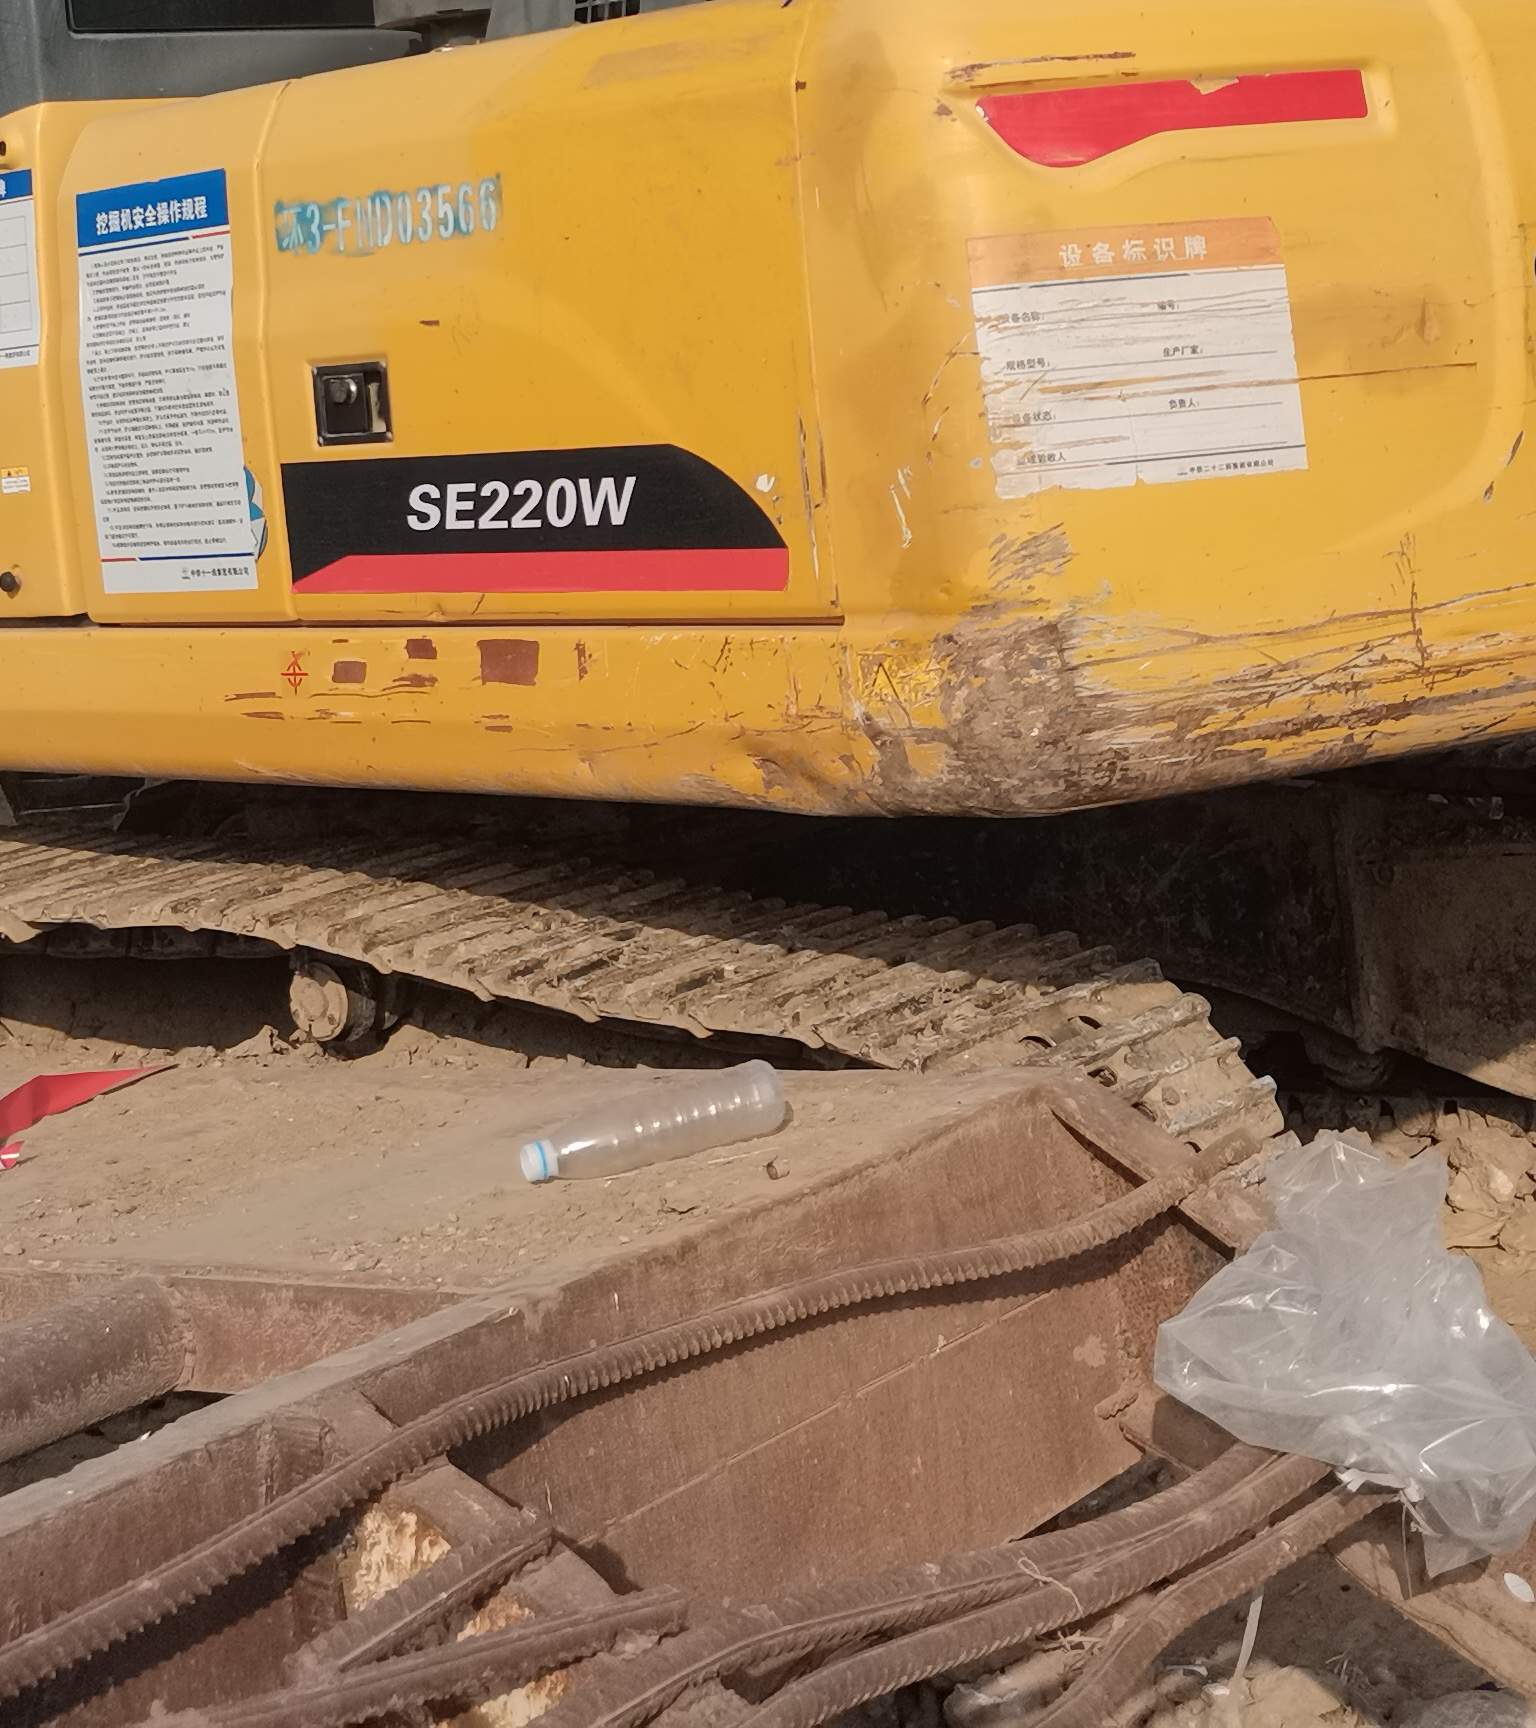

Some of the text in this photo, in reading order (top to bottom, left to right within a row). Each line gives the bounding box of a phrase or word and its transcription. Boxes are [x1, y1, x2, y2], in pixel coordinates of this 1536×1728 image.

[96, 196, 208, 236] 挖掘机安全操作规程
[1059, 235, 1208, 267] 设备标识牌
[406, 476, 637, 531] SE220W
